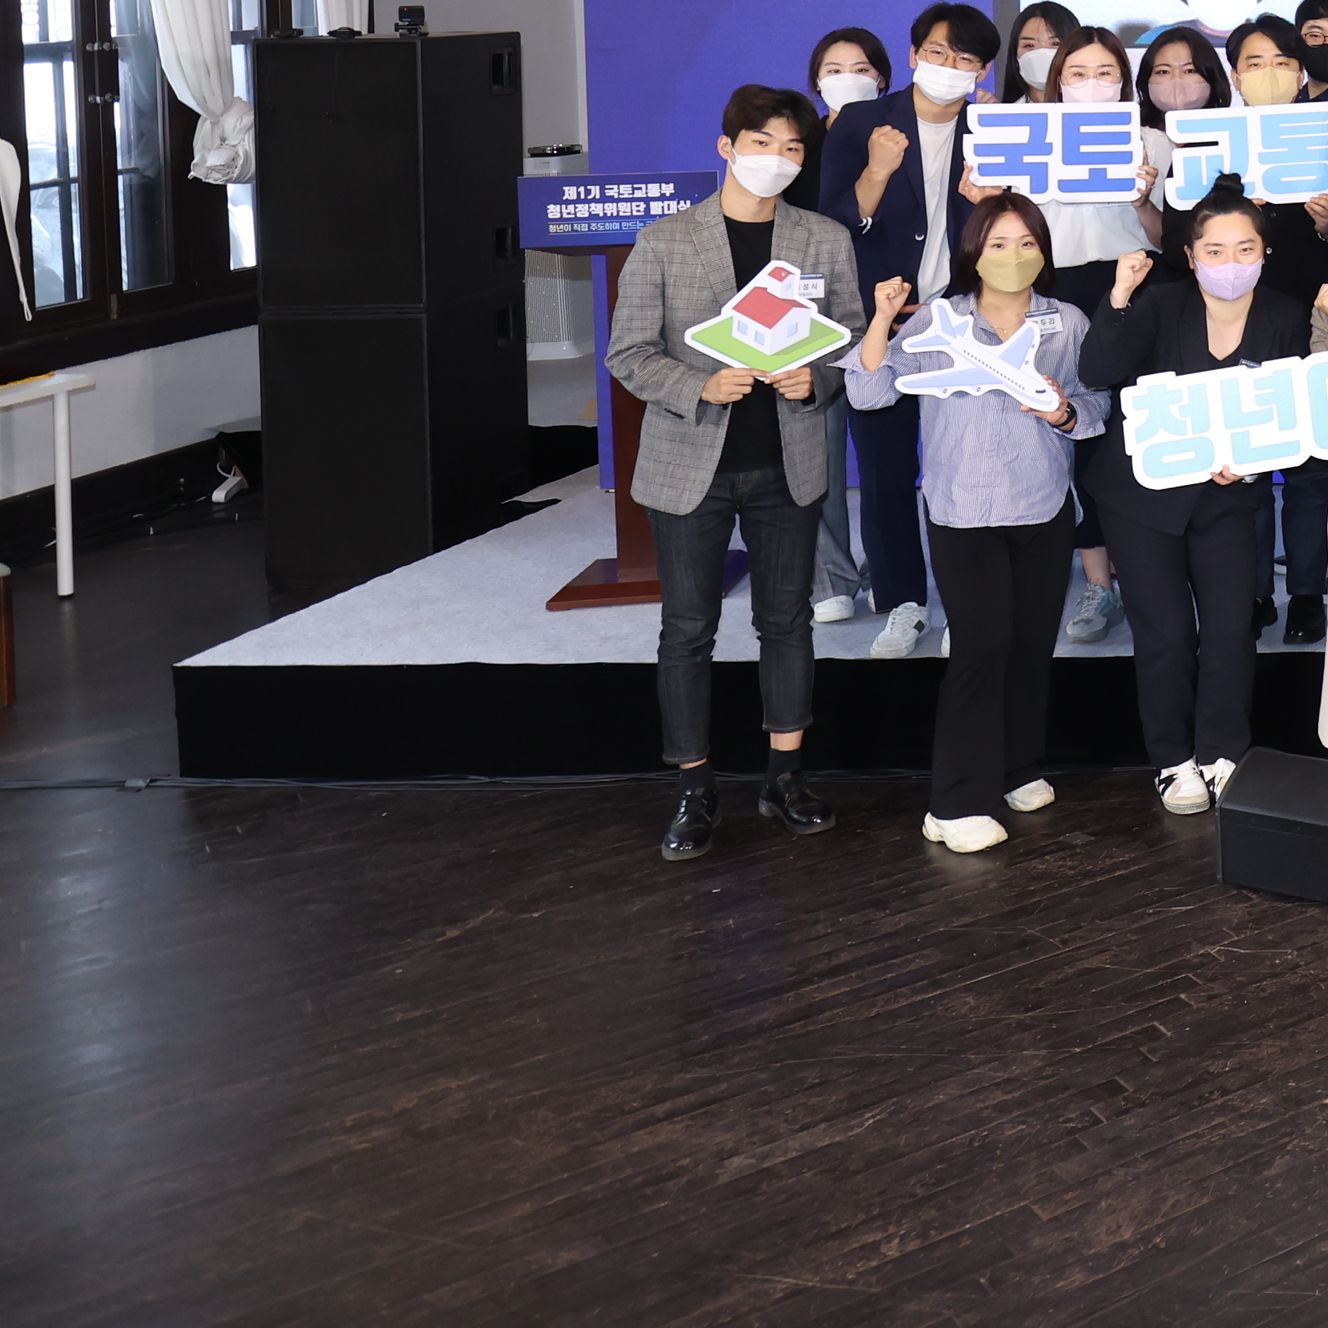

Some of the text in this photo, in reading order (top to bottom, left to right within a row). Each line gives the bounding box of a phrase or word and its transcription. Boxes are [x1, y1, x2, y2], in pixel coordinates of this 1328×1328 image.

[973, 112, 1138, 195] 국토
[563, 182, 675, 200] 제1기 국토교통부
[546, 201, 646, 219] 청년정책위원단
[548, 224, 572, 233] 청년이
[572, 223, 589, 232] 직접
[589, 222, 620, 232] 주도하며
[621, 220, 645, 230] 만드는
[798, 282, 818, 291] 성식
